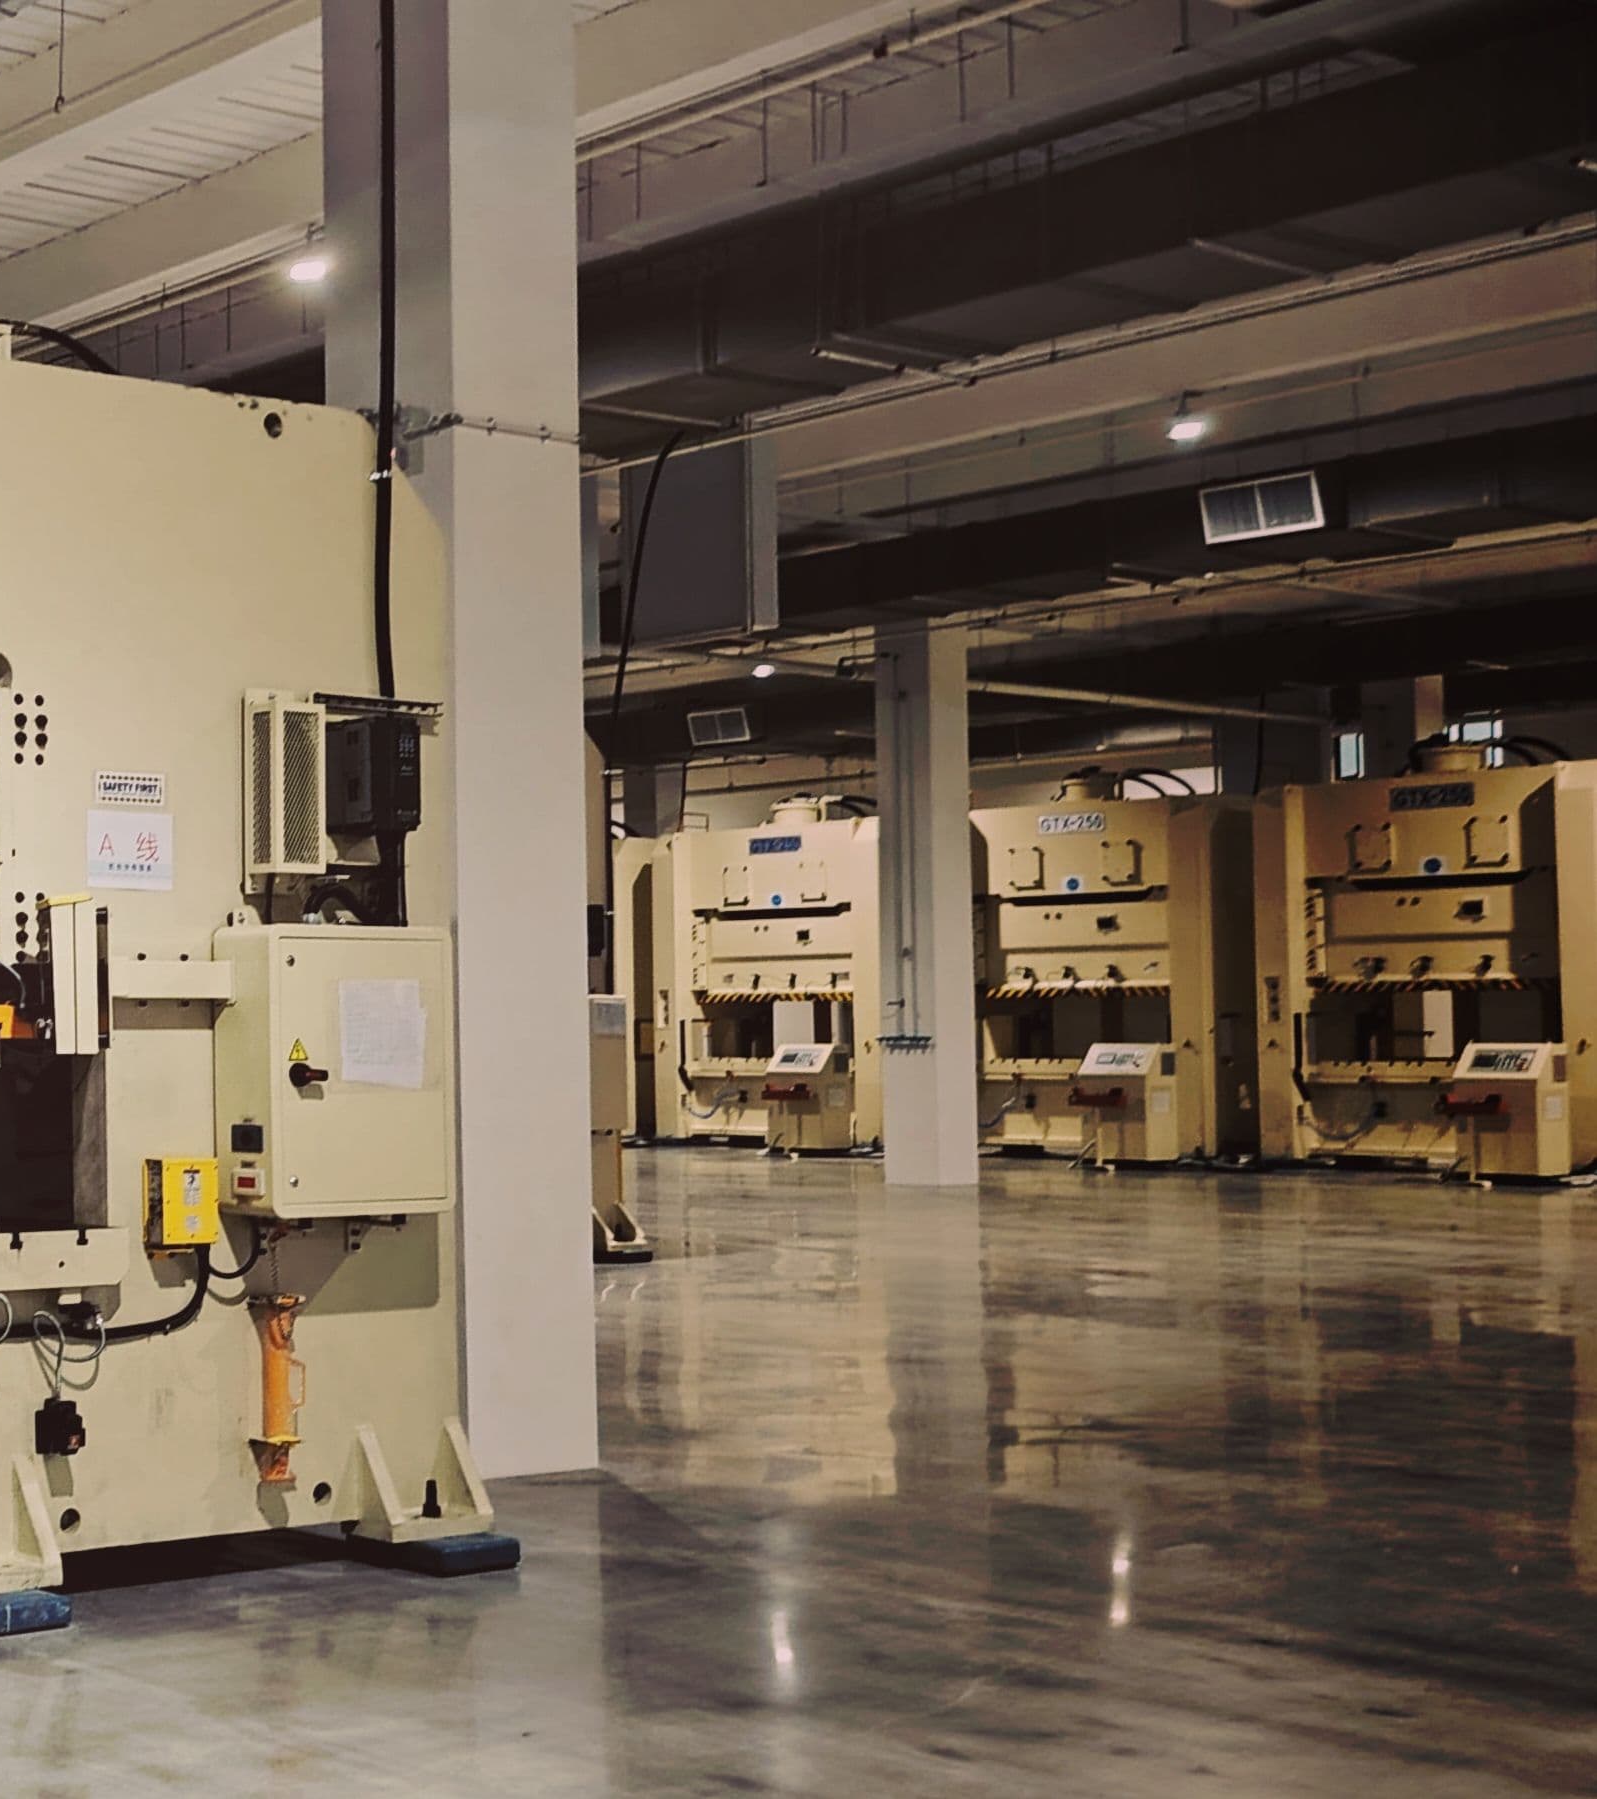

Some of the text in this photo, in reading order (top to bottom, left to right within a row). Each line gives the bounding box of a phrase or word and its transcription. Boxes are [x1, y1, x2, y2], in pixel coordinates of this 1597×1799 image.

[103, 781, 133, 793] SAFETY
[135, 783, 158, 794] FIRST
[99, 832, 115, 857] A
